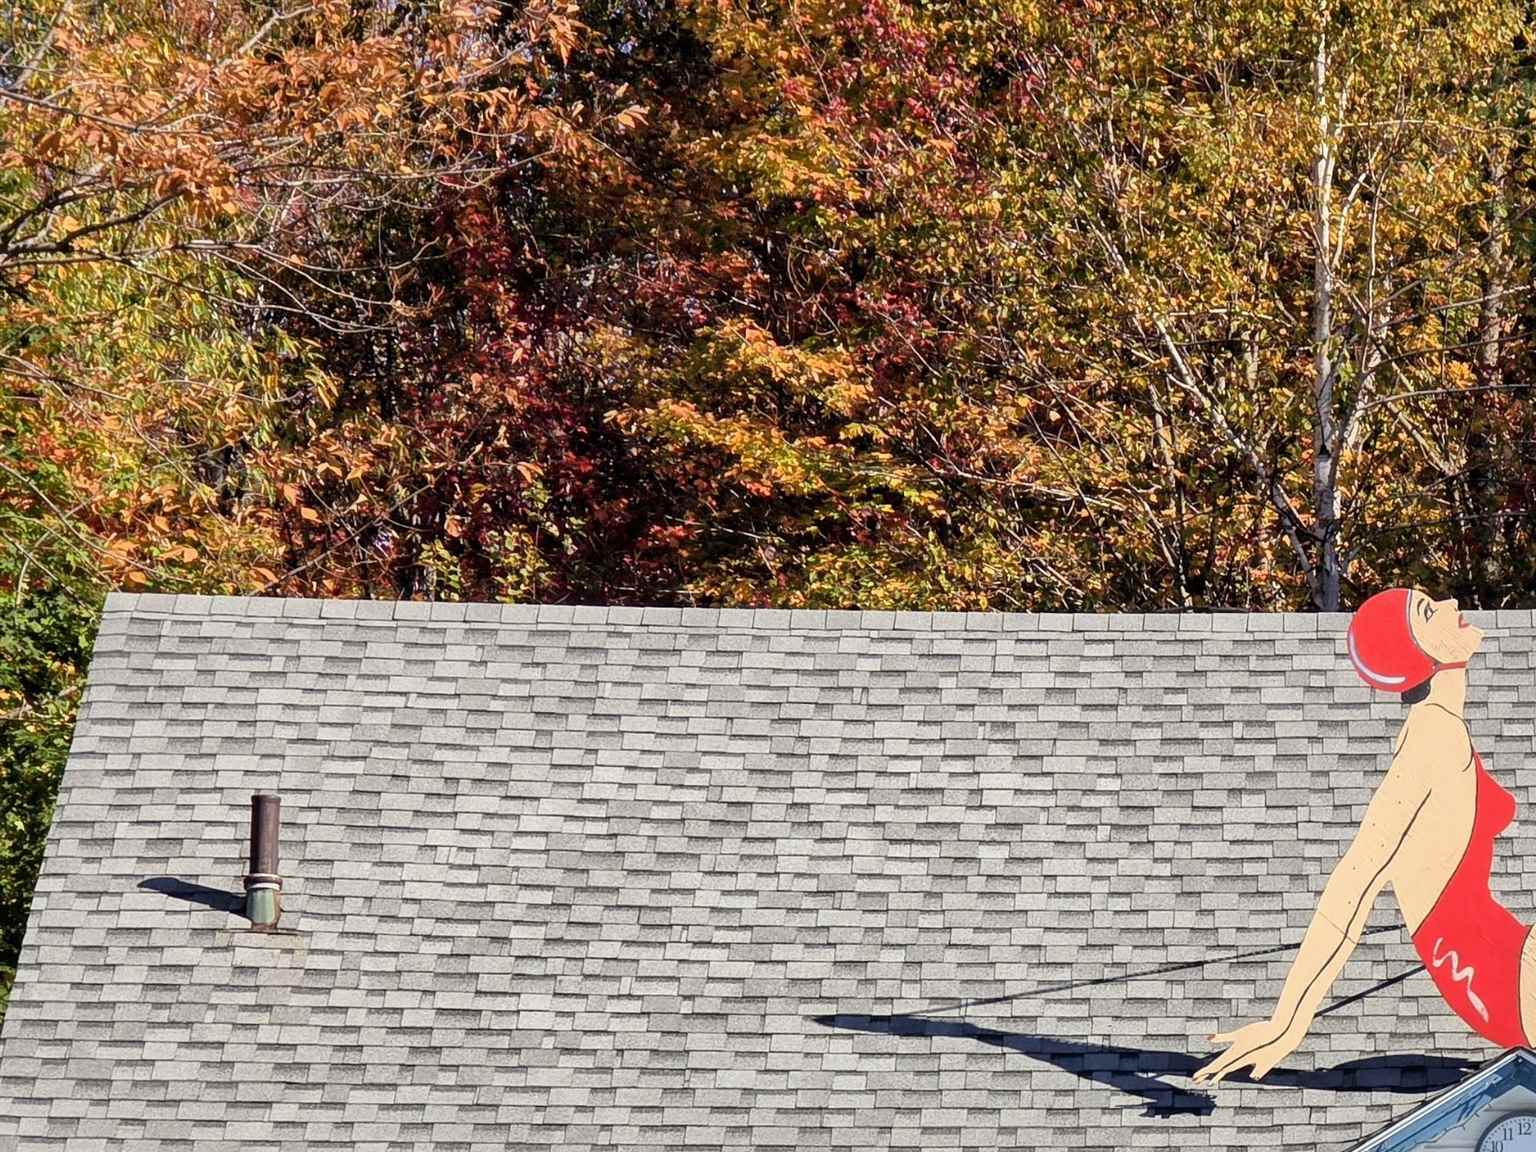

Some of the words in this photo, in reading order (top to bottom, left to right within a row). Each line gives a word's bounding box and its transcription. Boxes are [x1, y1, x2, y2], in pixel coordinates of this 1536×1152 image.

[1503, 1128, 1513, 1141] 11
[1518, 1122, 1532, 1135] 12
[1491, 1140, 1503, 1152] 10
